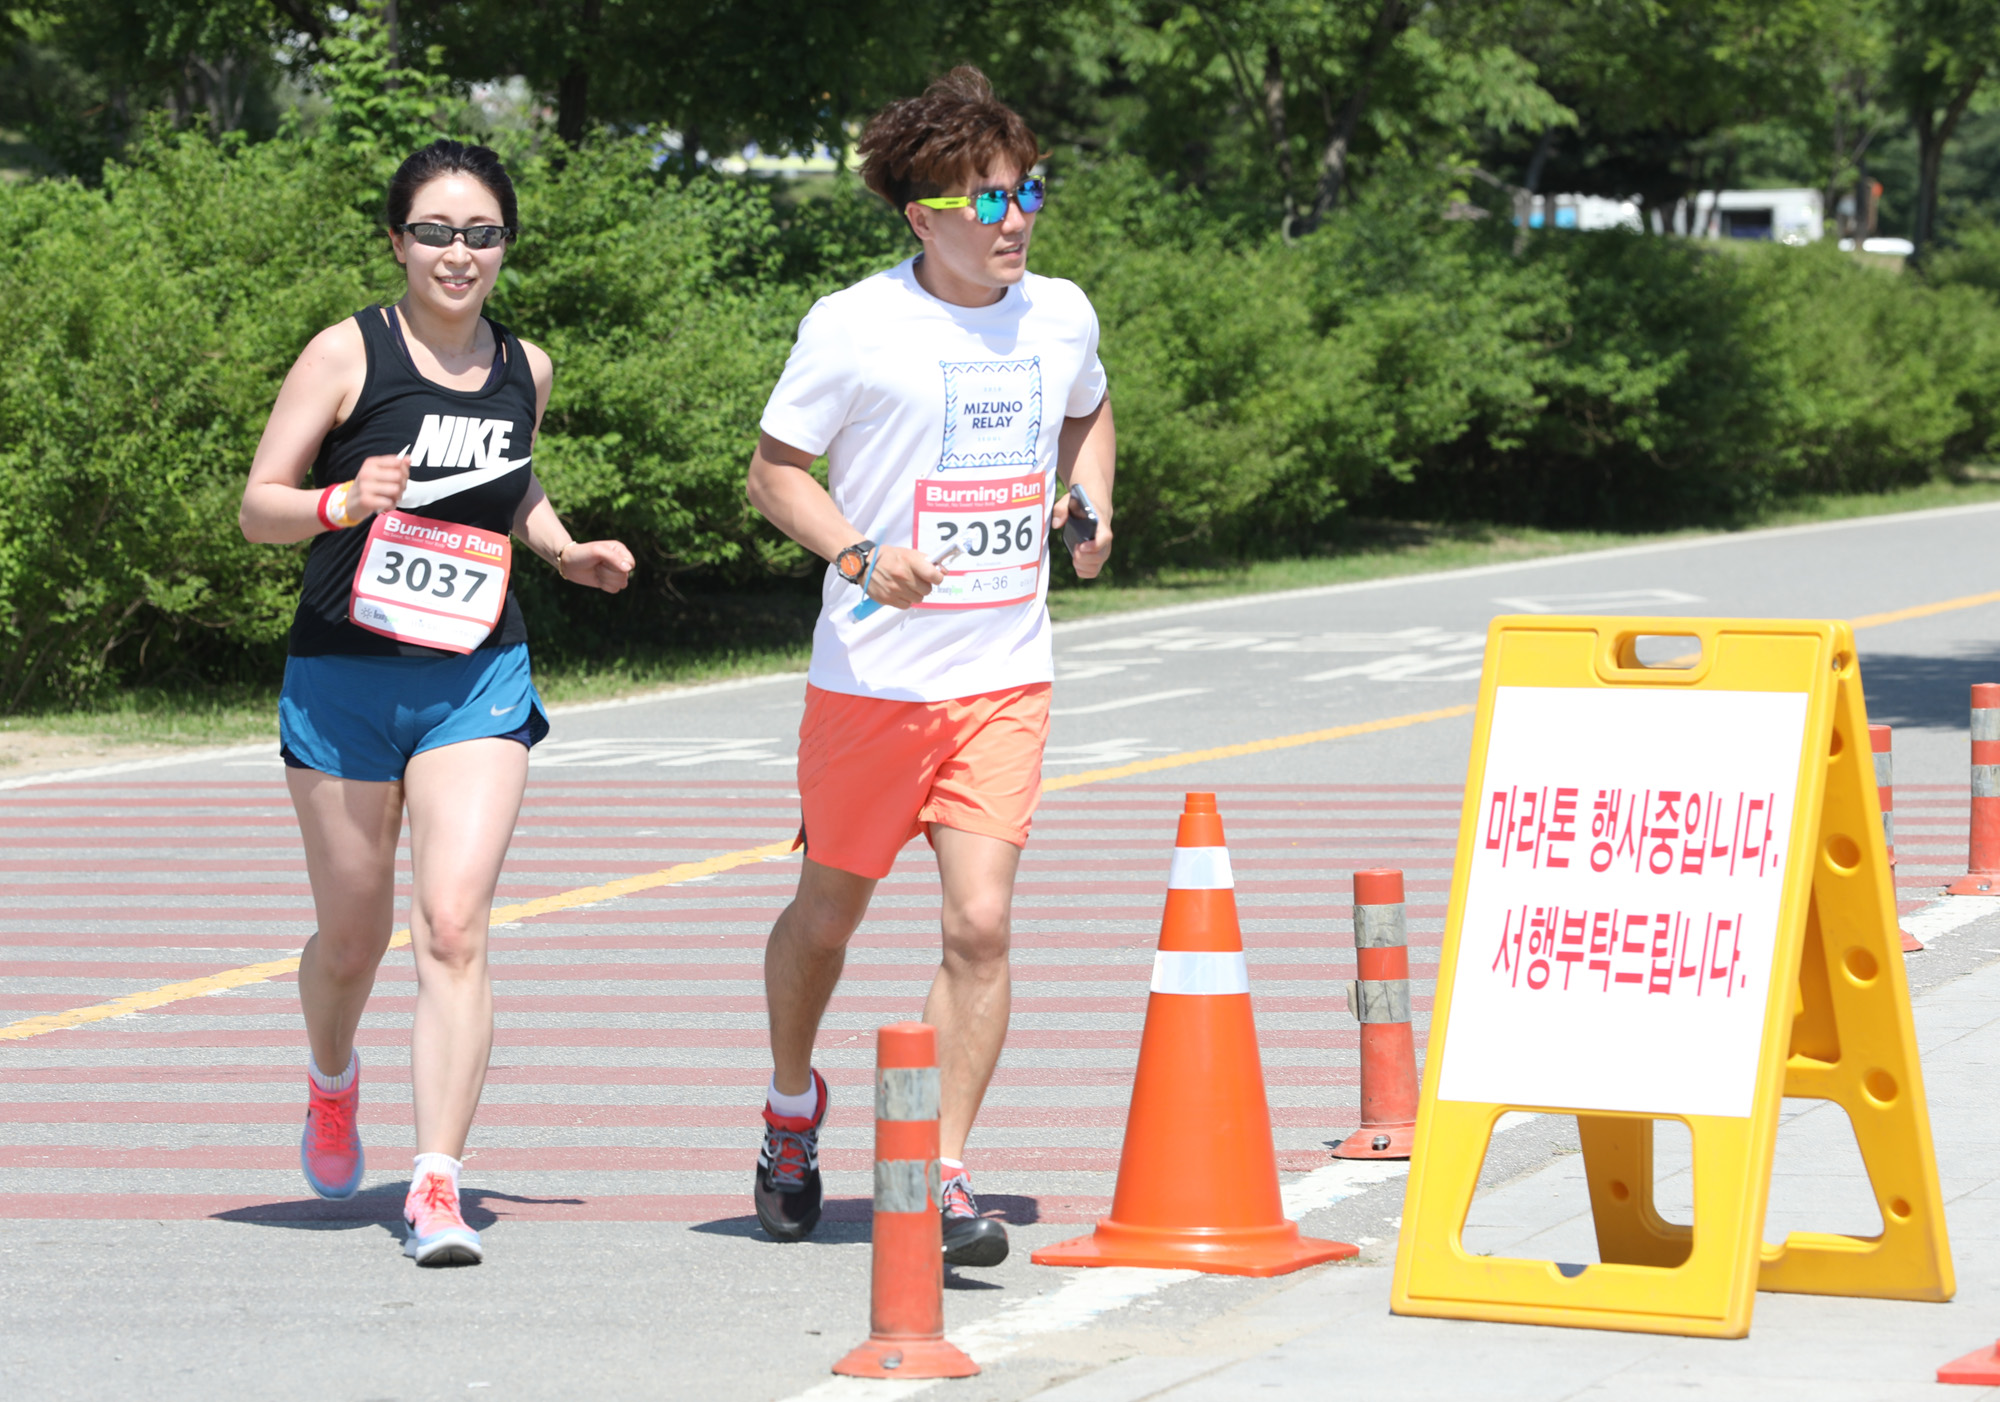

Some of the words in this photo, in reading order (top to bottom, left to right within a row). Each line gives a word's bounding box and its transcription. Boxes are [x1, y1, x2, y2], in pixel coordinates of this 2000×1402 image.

[963, 400, 1023, 415] MIZUNO
[972, 416, 1013, 429] RELAY
[410, 414, 514, 468] NIKE
[926, 486, 1008, 504] Burning
[1011, 482, 1041, 498] Run
[383, 516, 462, 549] Burning
[465, 534, 504, 557] Run
[376, 551, 488, 603] 3037
[971, 575, 1008, 592] A-36
[1485, 785, 1579, 869] 마라톤
[1589, 787, 1779, 877] 행사중입니다.
[1491, 904, 1747, 998] 서행부탁드립니다.
